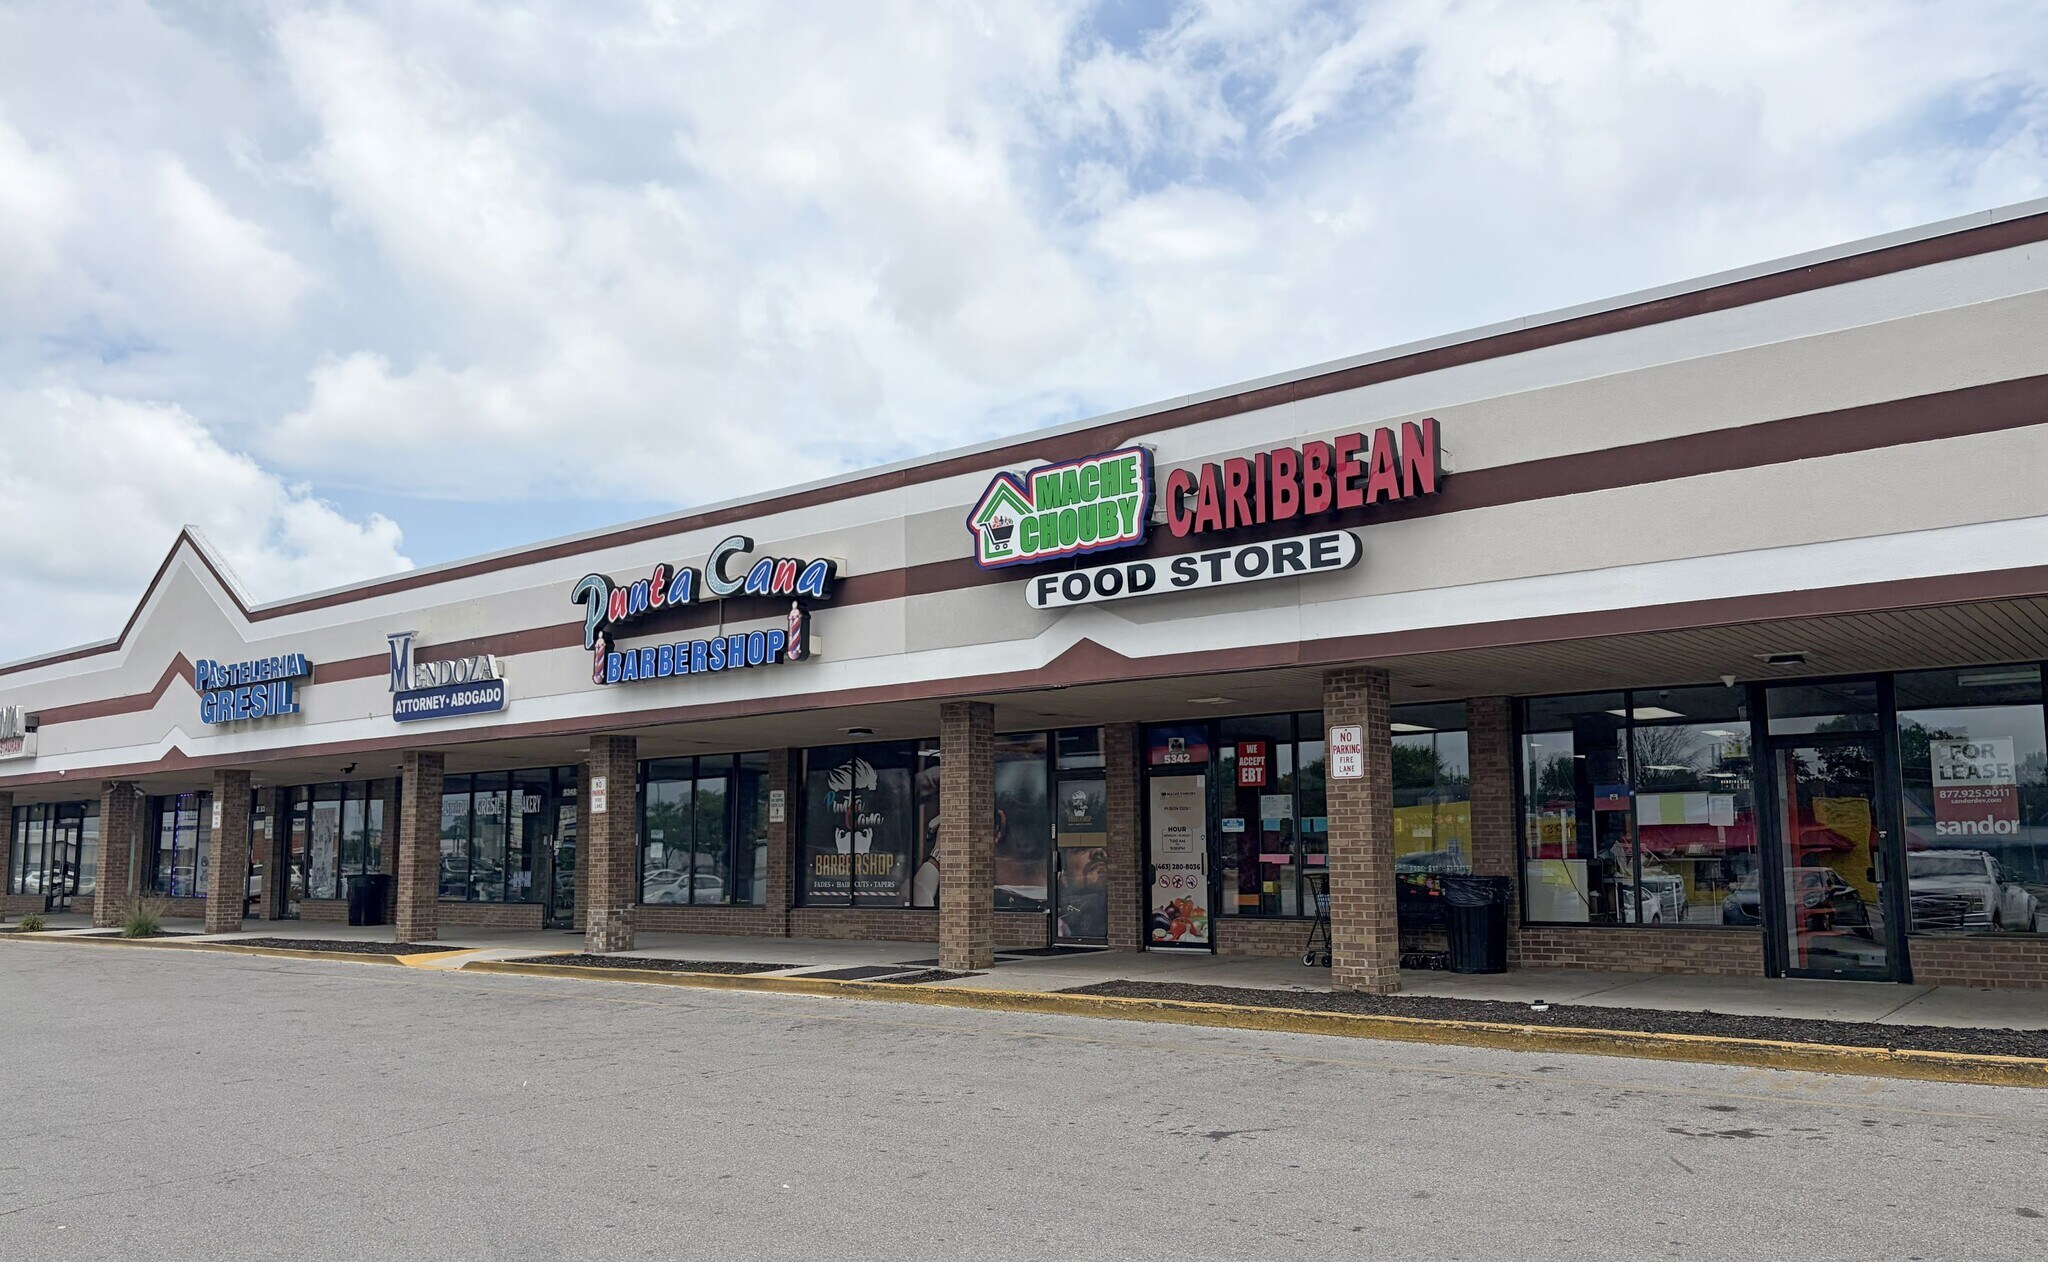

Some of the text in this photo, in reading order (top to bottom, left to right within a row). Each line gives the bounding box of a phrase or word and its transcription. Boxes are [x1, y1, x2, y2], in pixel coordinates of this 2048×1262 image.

[1035, 456, 1137, 511] MACHE
[1166, 418, 1441, 537] CARIBBEAN
[1020, 496, 1138, 553] CHOUBY
[1037, 534, 1342, 605] FOOD STORE
[572, 535, 836, 649] Punta Cana
[606, 629, 785, 683] BARBERSHOP
[195, 653, 307, 691] PASTELERIA
[200, 681, 299, 724] GRESIL
[395, 687, 501, 714] ATTORNEY ABOGADO
[1340, 732, 1352, 742] NO
[1164, 753, 1191, 764] 5342
[1246, 744, 1258, 754] WE
[1333, 743, 1361, 754] PARKING
[1949, 744, 1996, 760] FOR
[1239, 756, 1265, 766] ACCEPT
[1339, 764, 1355, 773] LANE
[1242, 767, 1263, 783] EBT
[1939, 763, 2010, 780] LEASE
[519, 794, 541, 813] BAKERY
[1939, 788, 2010, 799] 877.925.9011
[1935, 814, 2020, 836] sandor
[815, 853, 894, 876] BARBERSHOP
